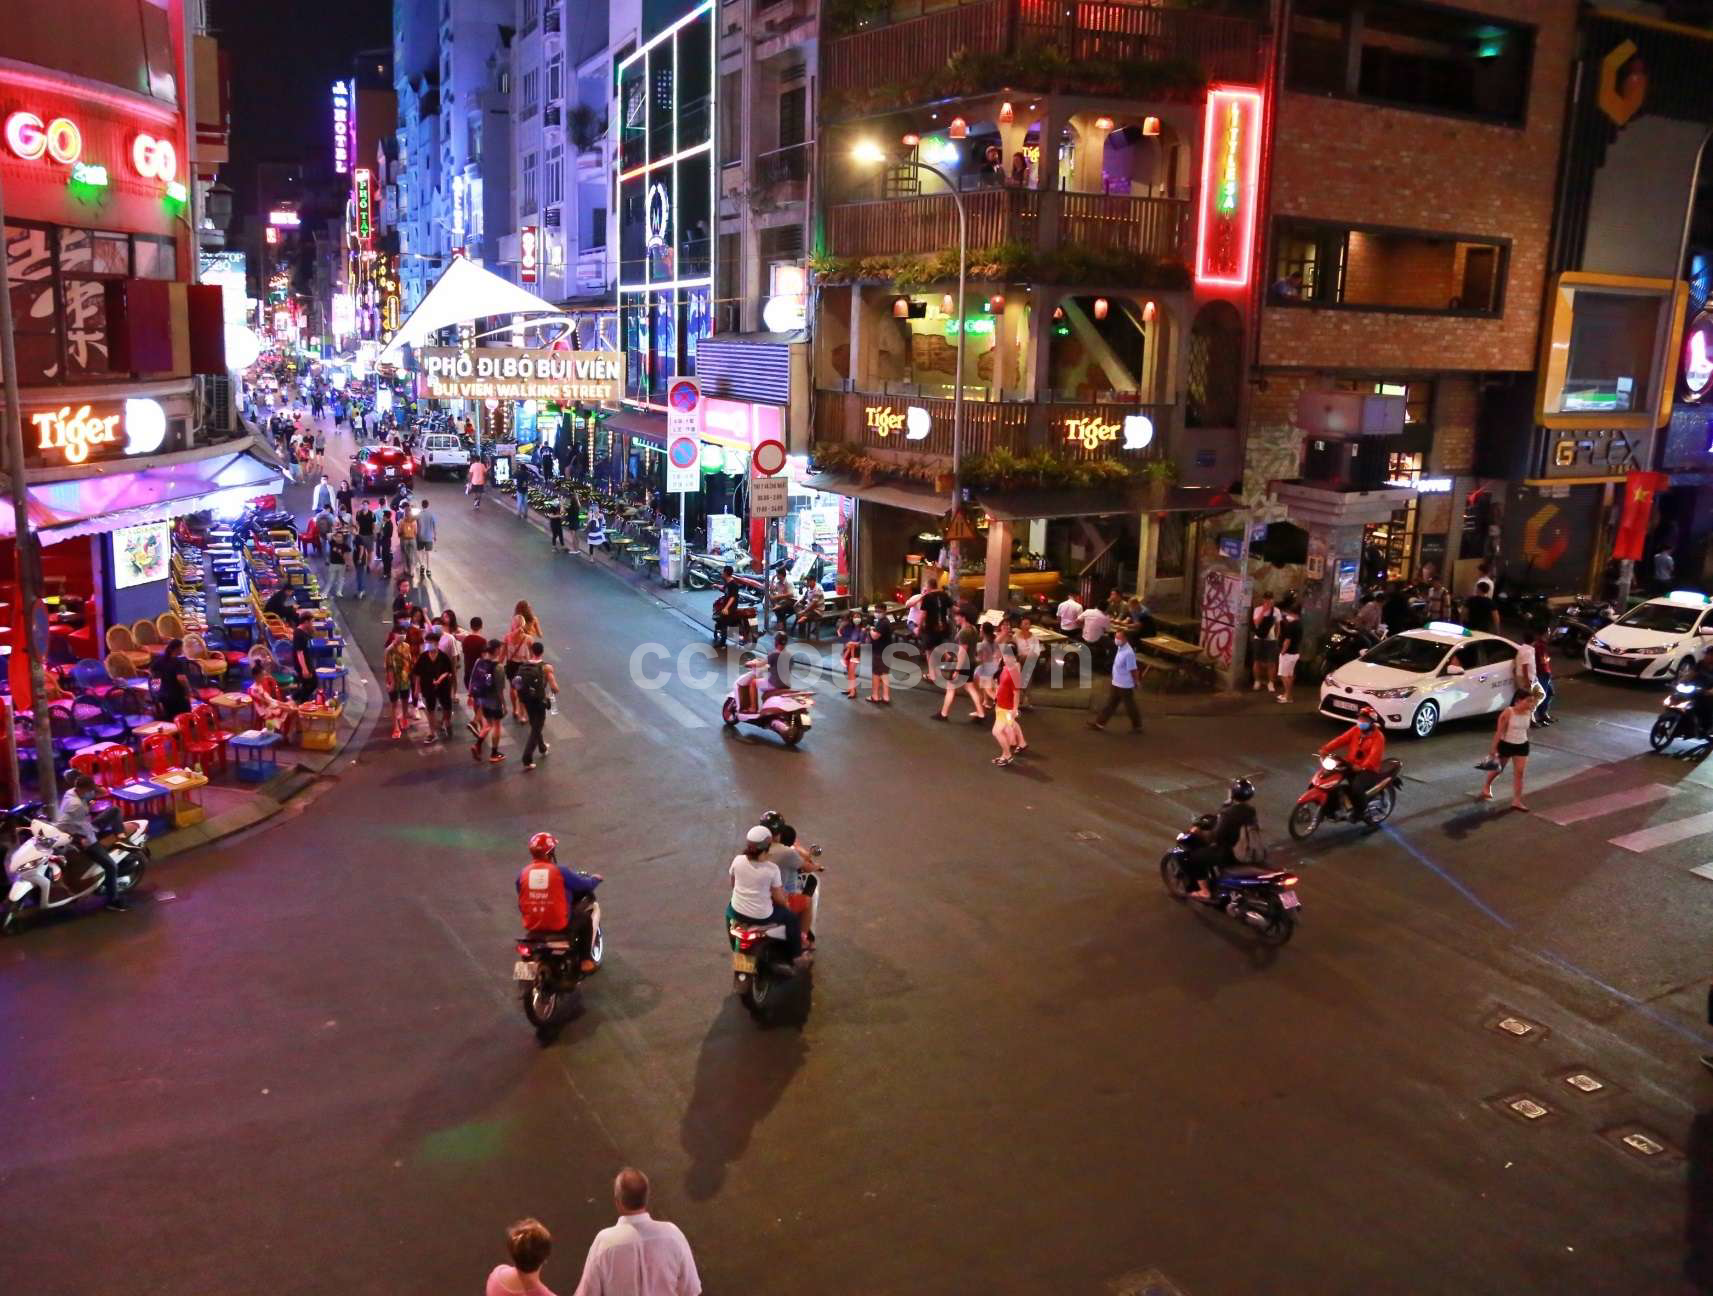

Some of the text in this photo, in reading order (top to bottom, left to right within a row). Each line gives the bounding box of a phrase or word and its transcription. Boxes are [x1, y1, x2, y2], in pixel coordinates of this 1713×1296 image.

[6, 112, 177, 182] GO GO
[333, 109, 348, 173] HOTEL
[537, 353, 572, 379] BÙI
[496, 383, 560, 398] WALKING
[561, 383, 611, 398] STREET
[32, 404, 120, 463] Tiger
[865, 406, 906, 437] Tiger
[1065, 416, 1122, 450] Tiger
